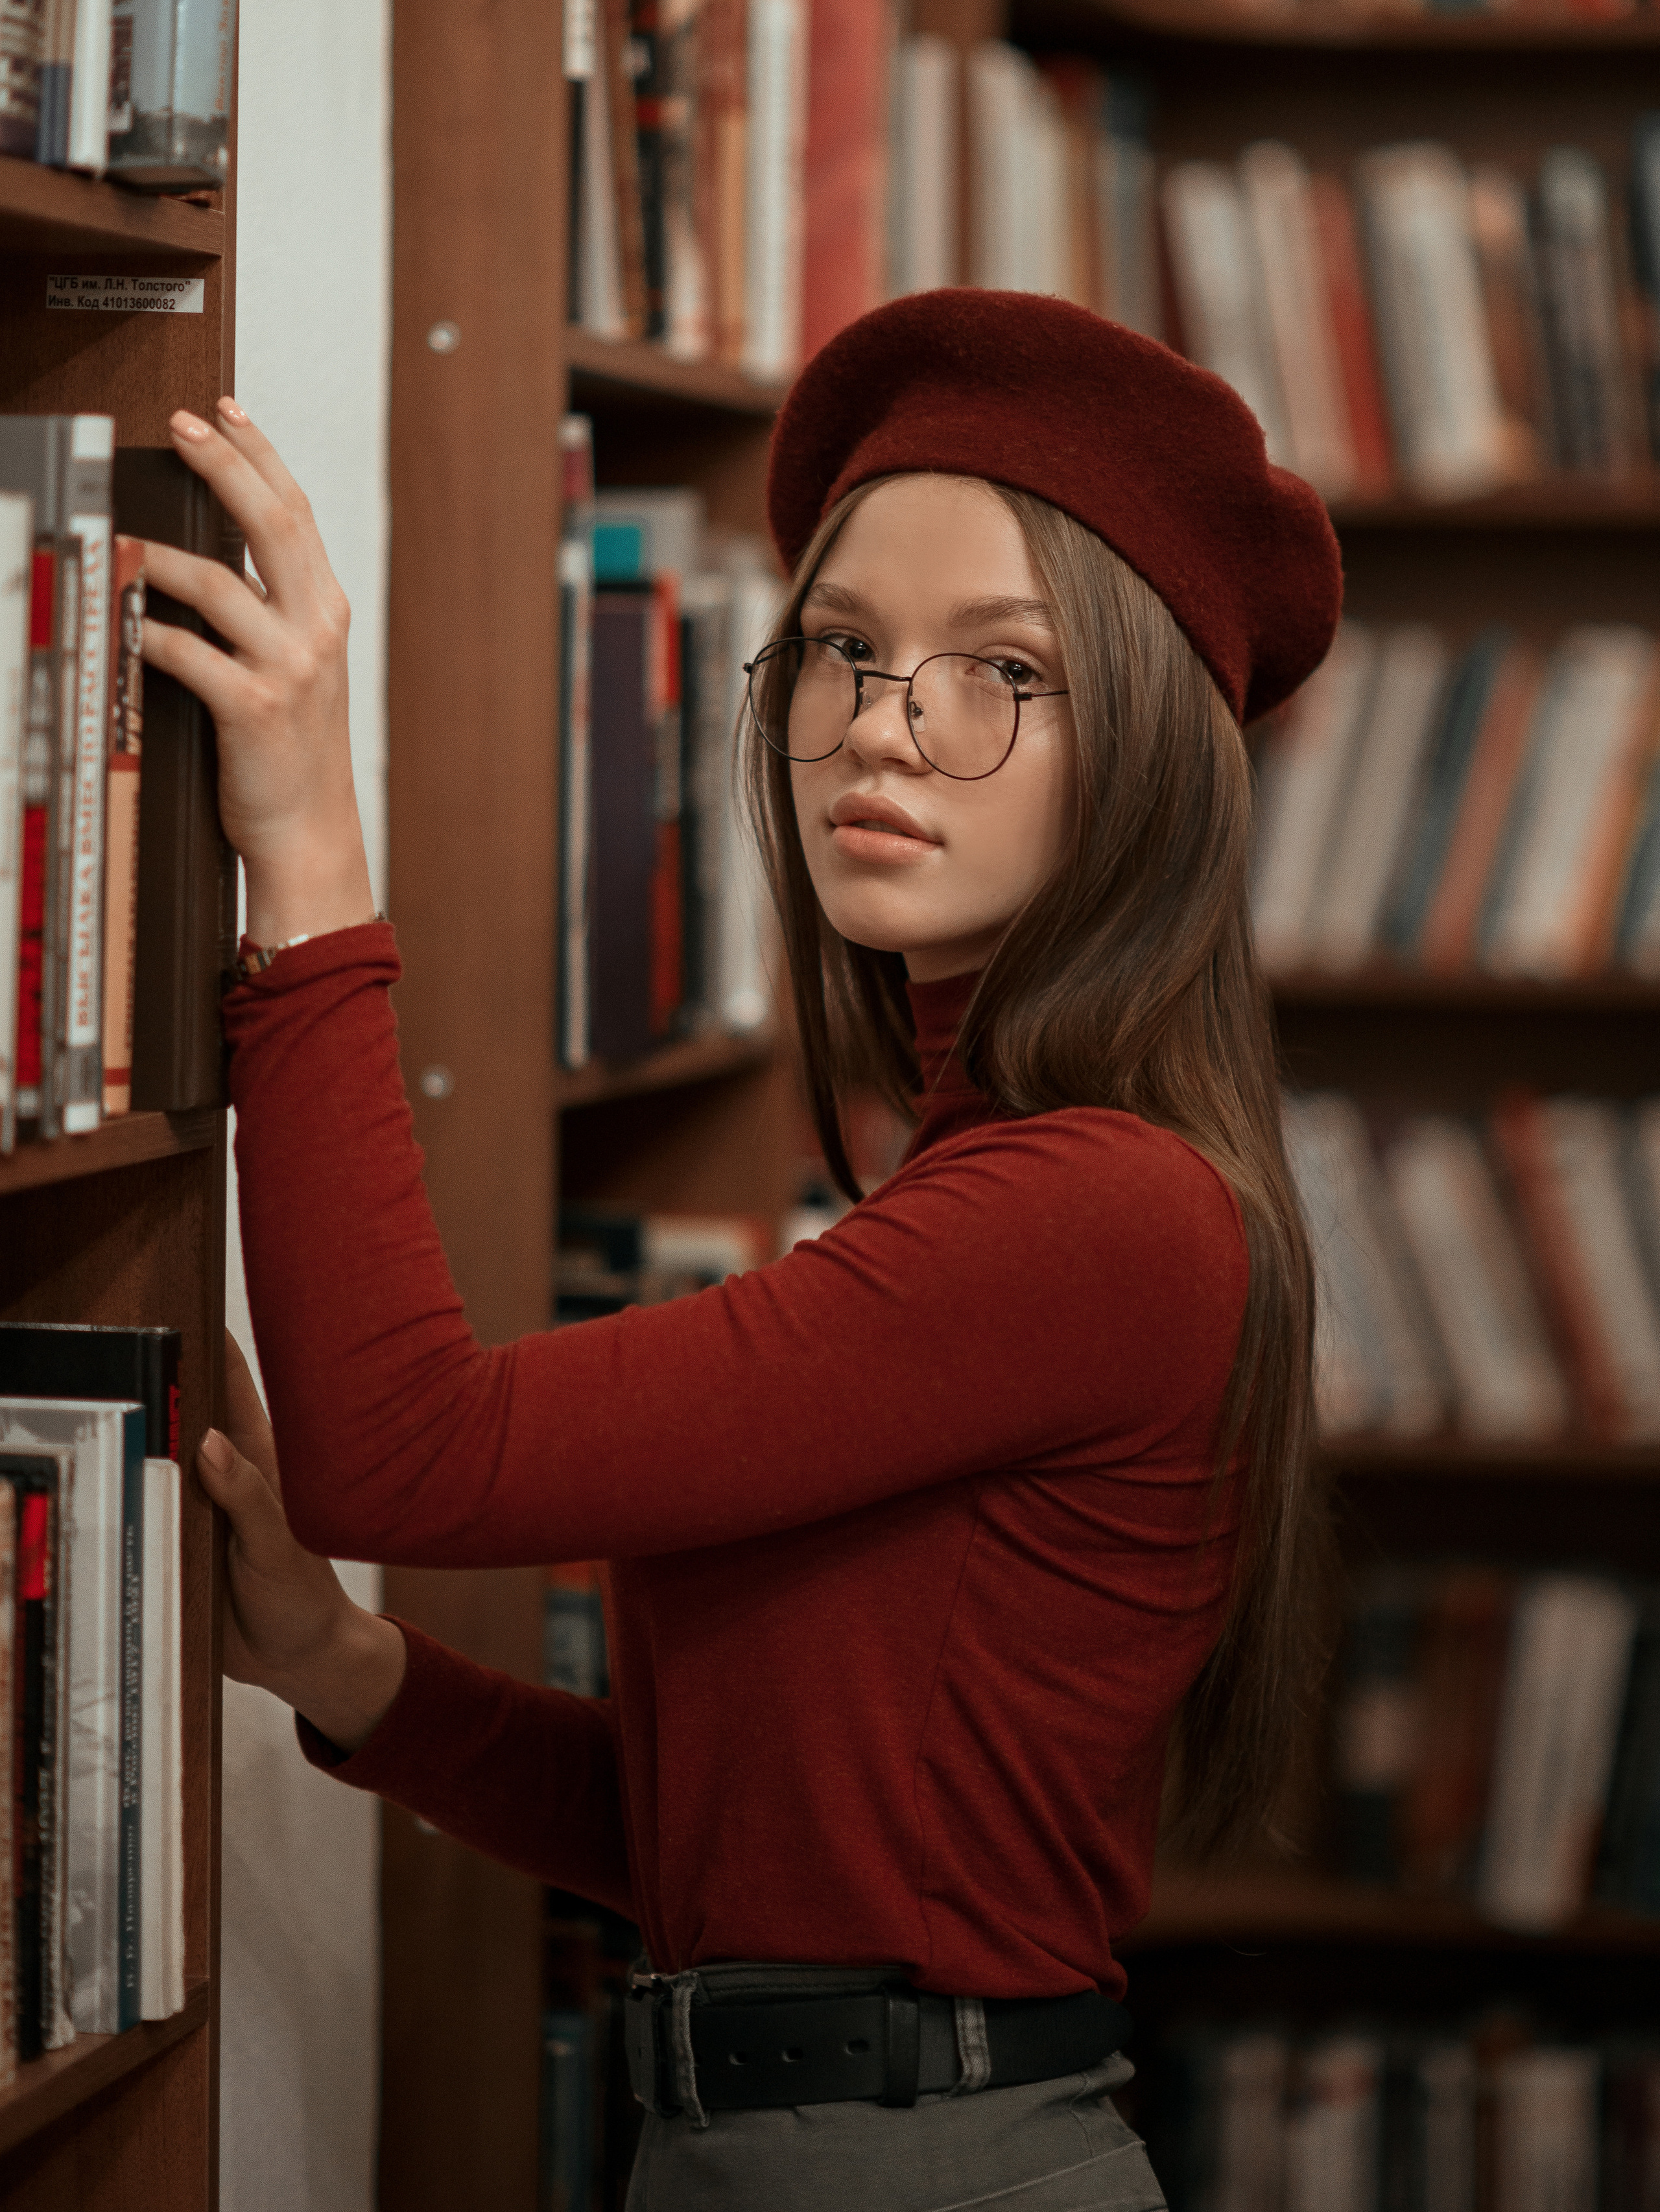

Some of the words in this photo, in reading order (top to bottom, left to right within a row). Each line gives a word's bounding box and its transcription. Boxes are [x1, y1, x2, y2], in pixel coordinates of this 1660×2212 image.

[49, 276, 78, 290] "ЦГБ
[82, 279, 100, 290] им.
[104, 278, 127, 290] Л.Н.
[132, 279, 191, 292] Толстого"
[48, 295, 74, 308] Инв.
[77, 296, 99, 309] Код
[102, 296, 175, 310] 41013600082
